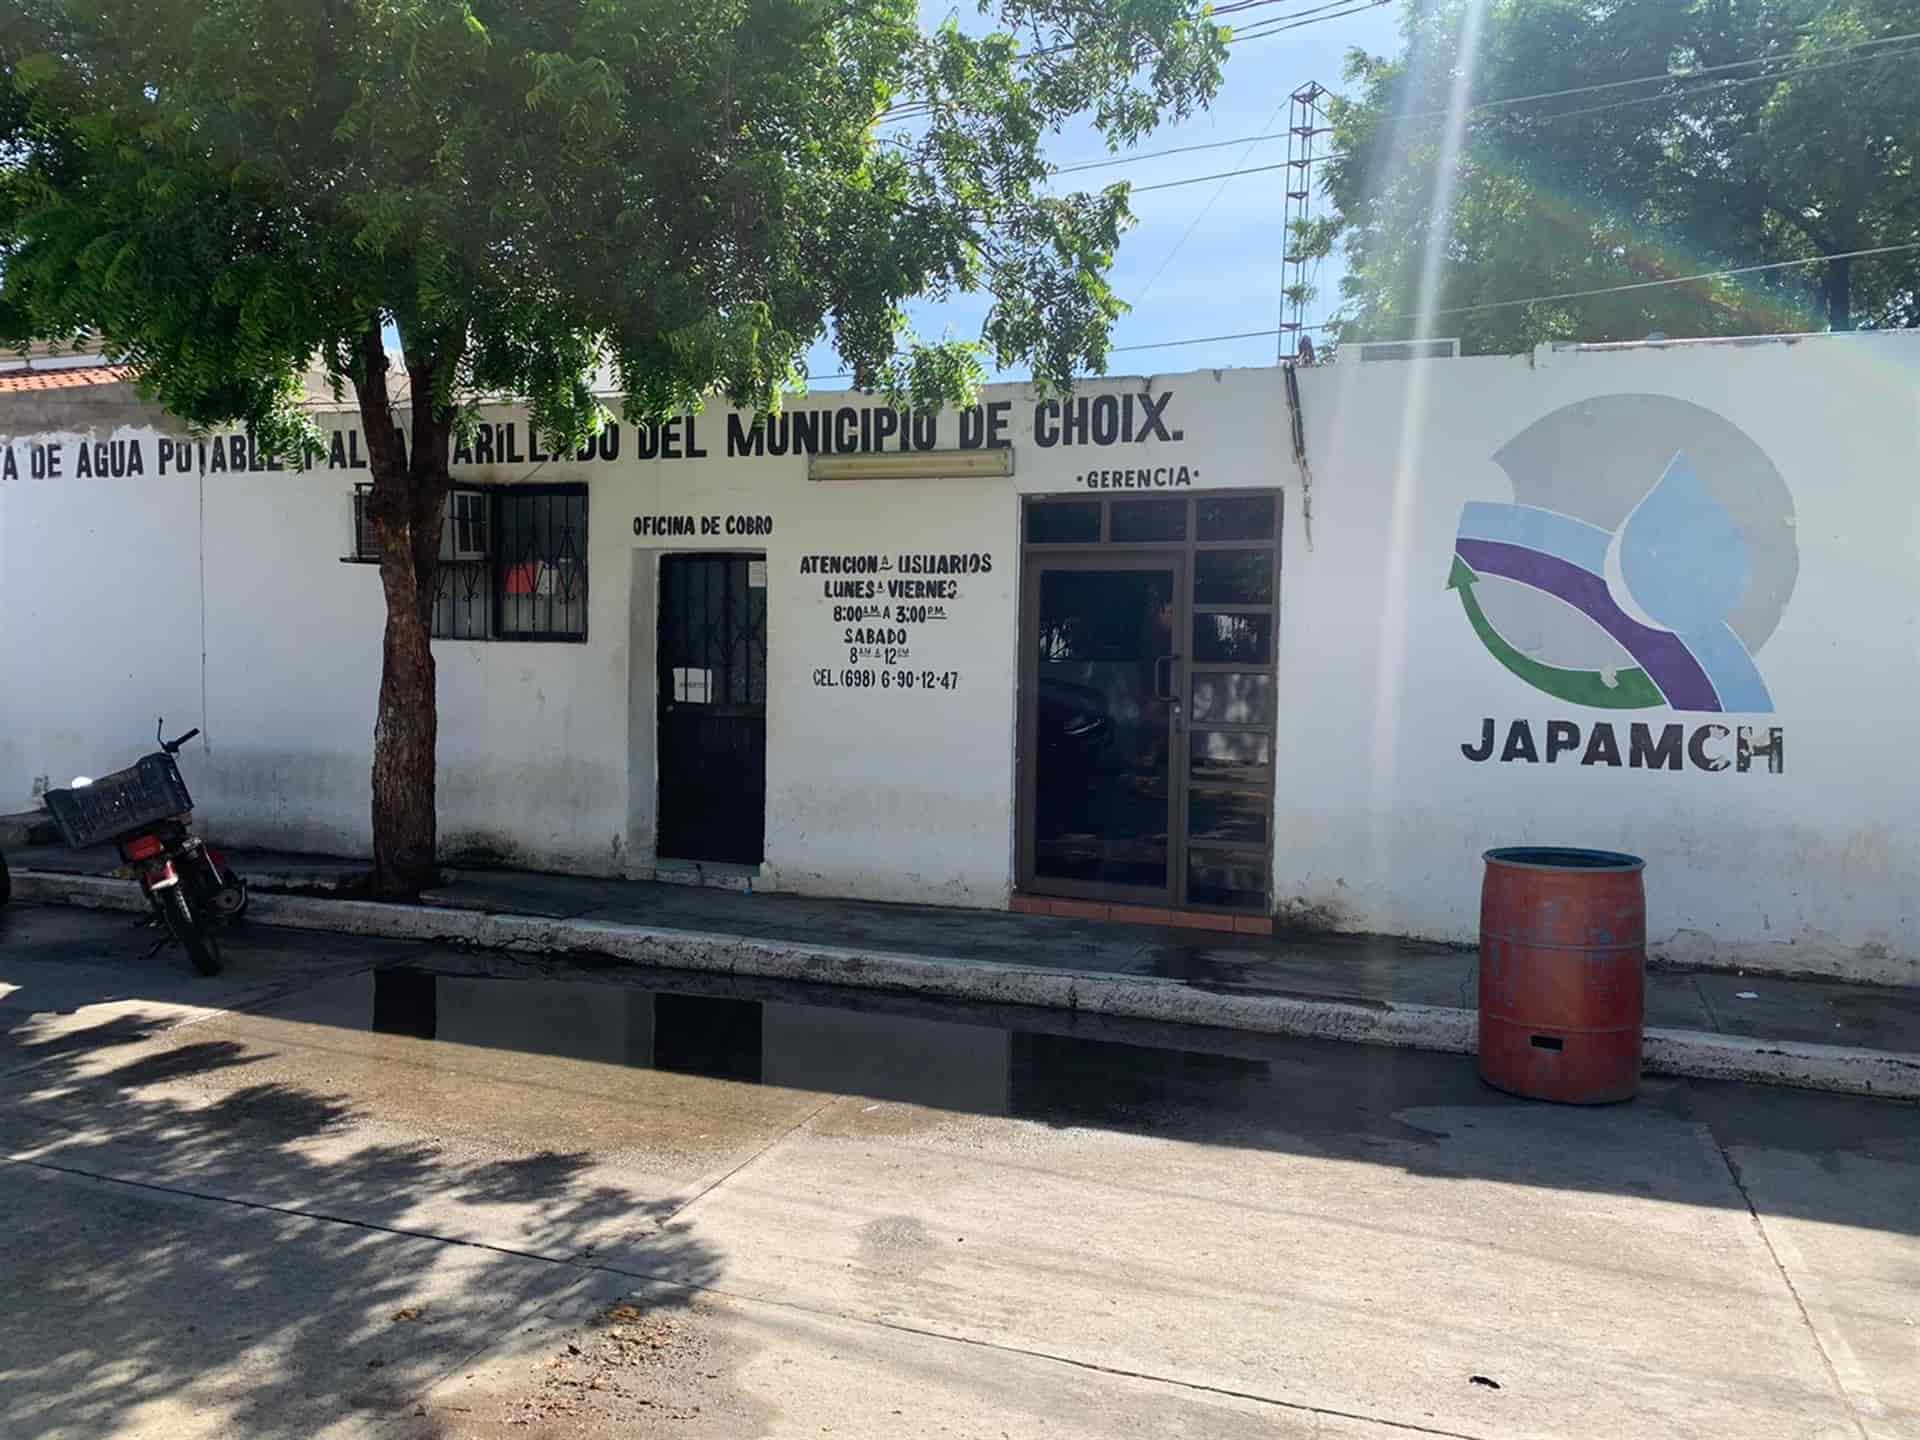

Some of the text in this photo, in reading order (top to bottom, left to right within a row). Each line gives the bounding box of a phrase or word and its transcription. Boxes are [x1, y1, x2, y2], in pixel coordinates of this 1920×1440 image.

[0, 444, 18, 480] A
[31, 443, 62, 479] DE
[76, 439, 144, 478] AGUA
[638, 412, 707, 459] DEL
[727, 405, 937, 458] MUNICIPIO
[960, 401, 1012, 449] DE
[1034, 391, 1184, 448] CHOIX.
[633, 515, 773, 536] OFICINA DE COBRO
[800, 555, 878, 574] ATENCION
[824, 579, 875, 599] LUNES
[888, 579, 958, 600] VIERNES
[882, 605, 890, 619] A
[844, 628, 907, 645] SABADO
[1461, 718, 1784, 774] JAPAMCH
